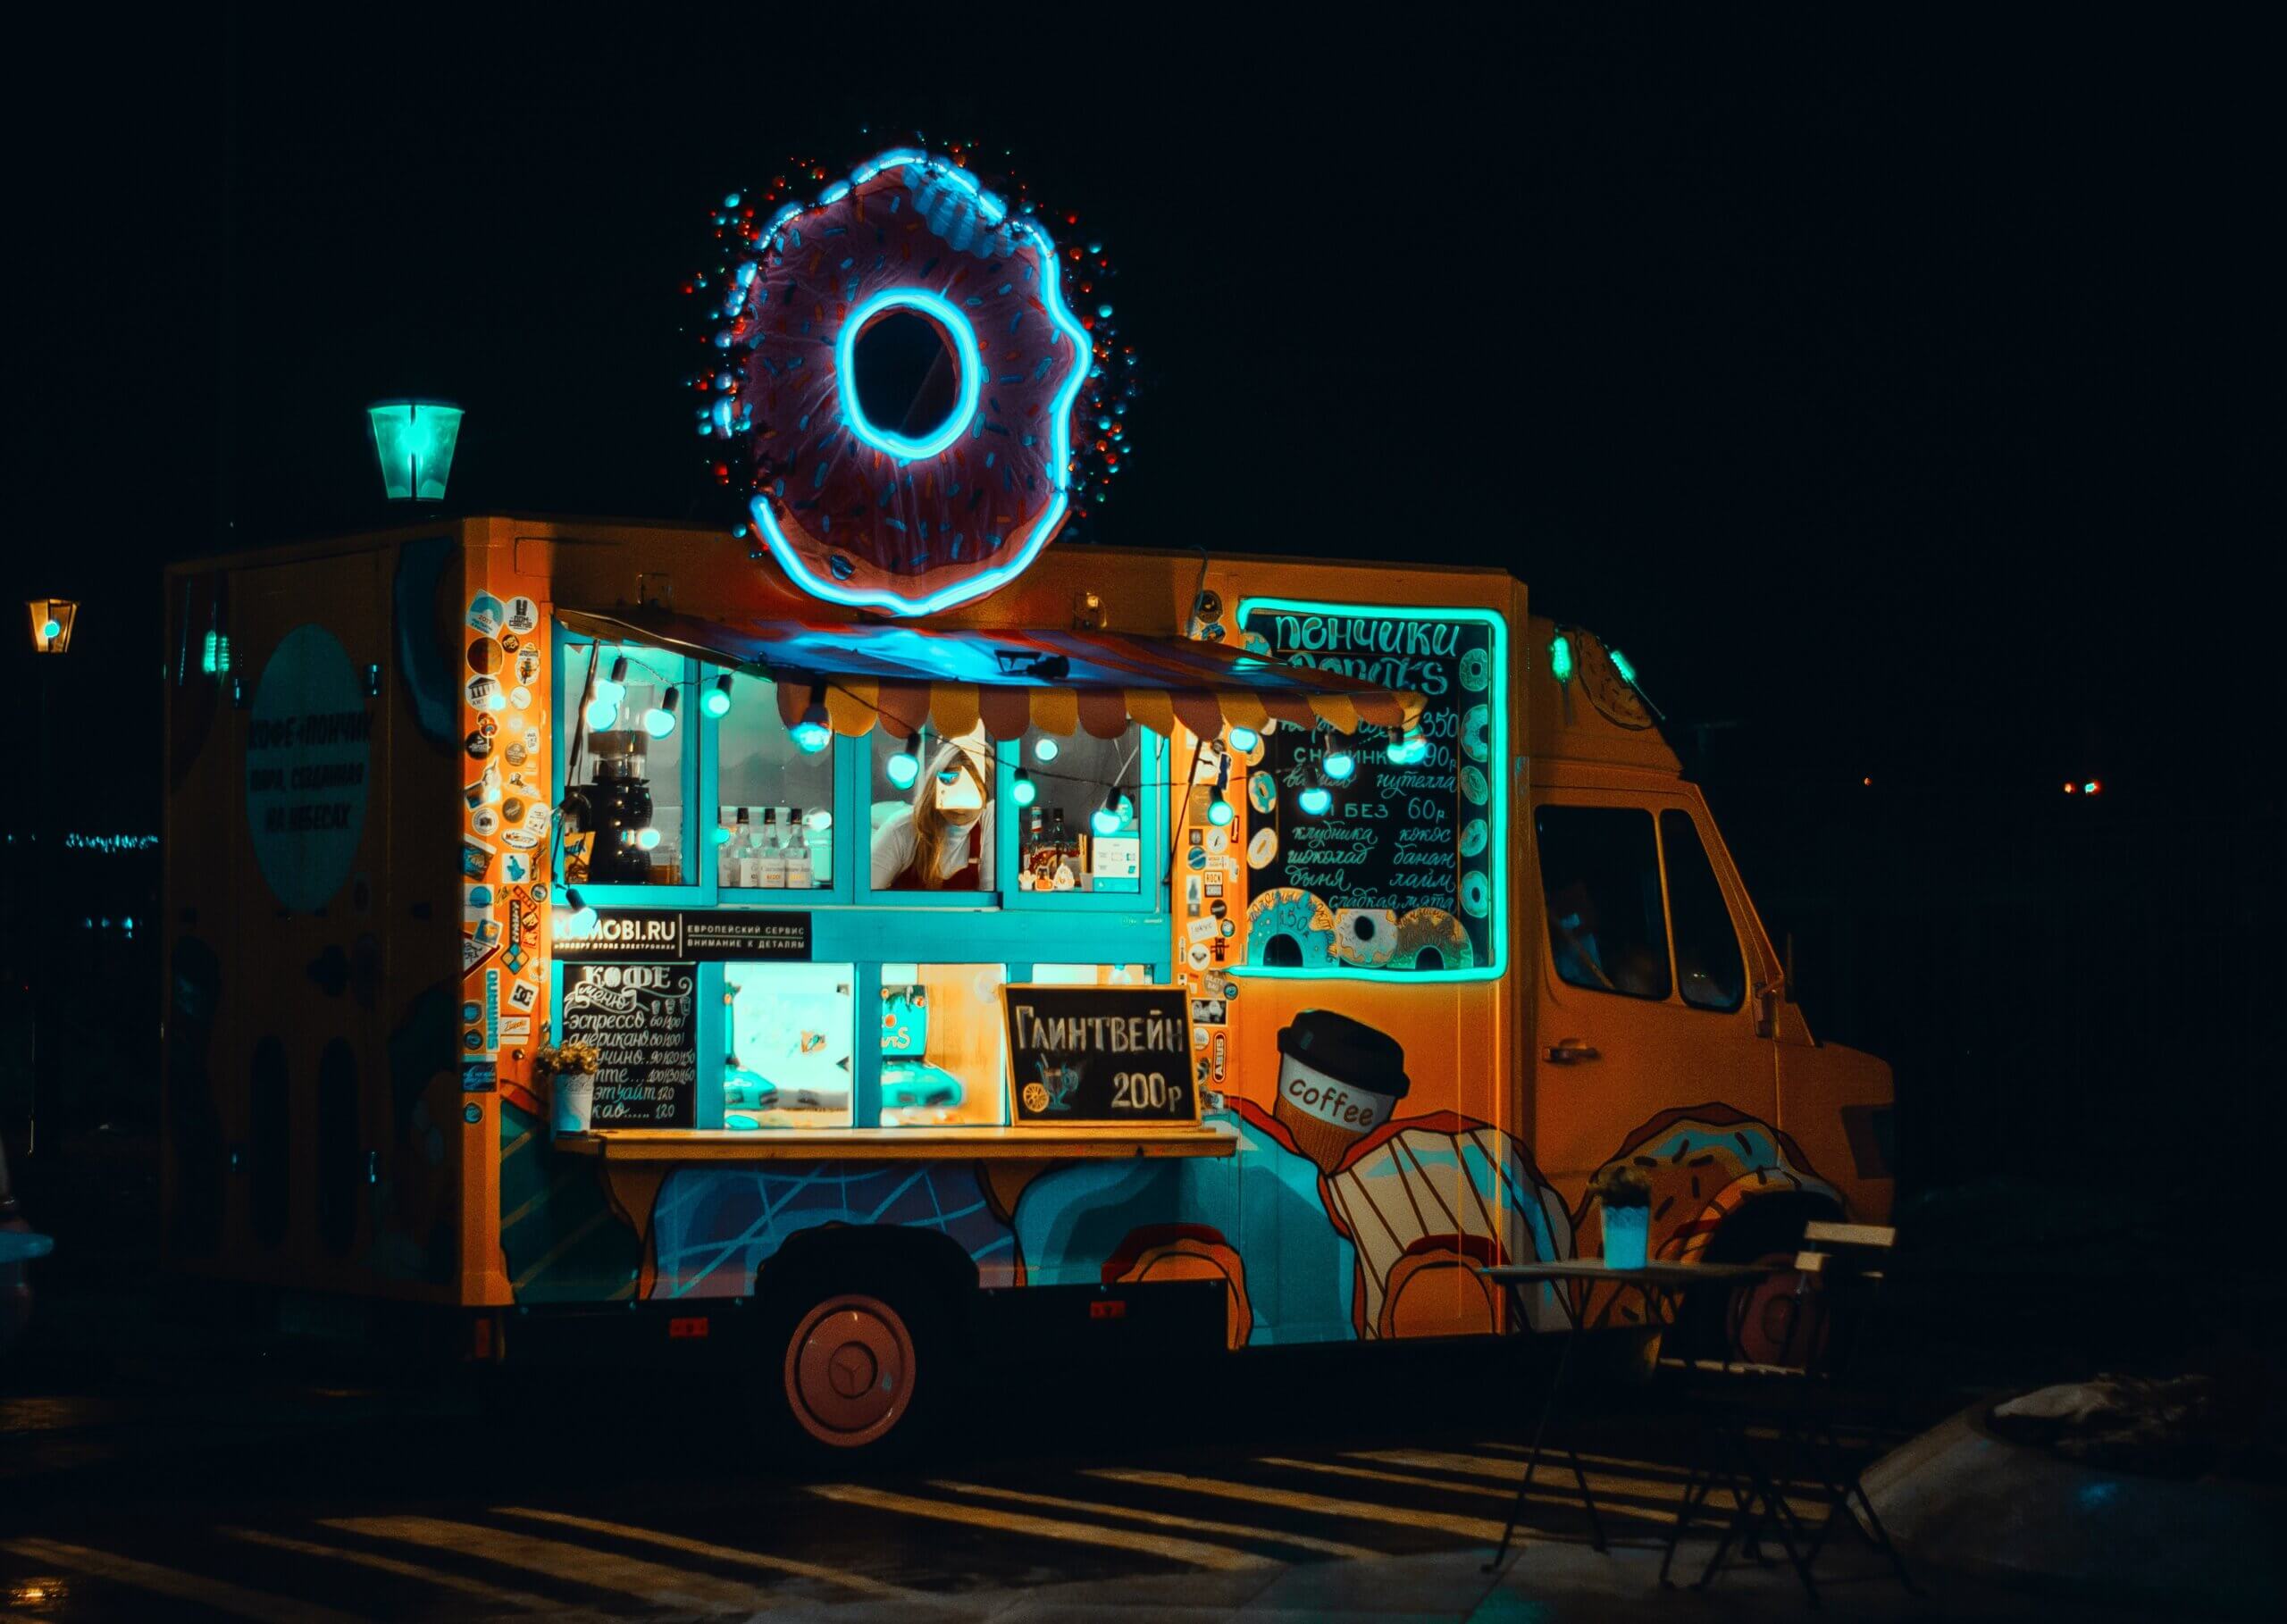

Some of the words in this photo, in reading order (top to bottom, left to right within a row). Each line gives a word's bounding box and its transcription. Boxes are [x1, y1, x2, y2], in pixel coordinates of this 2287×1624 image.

[1345, 803, 1388, 818] БЕЗ
[1292, 820, 1378, 848] клубника
[1399, 827, 1452, 841] кокос
[1287, 842, 1375, 865] шоколад
[1393, 842, 1456, 868] банан
[1389, 868, 1456, 893] лайм
[687, 925, 761, 933] ЕВРОПЕЙСКИЙ
[687, 939, 742, 948] ВНИМАНИЕ
[758, 941, 804, 950] ДЕТАЛЯМ
[582, 966, 671, 988] КОФЕ
[1111, 1072, 1182, 1113] 200р
[1289, 1078, 1374, 1127] coffee
[657, 1104, 674, 1118] 120
